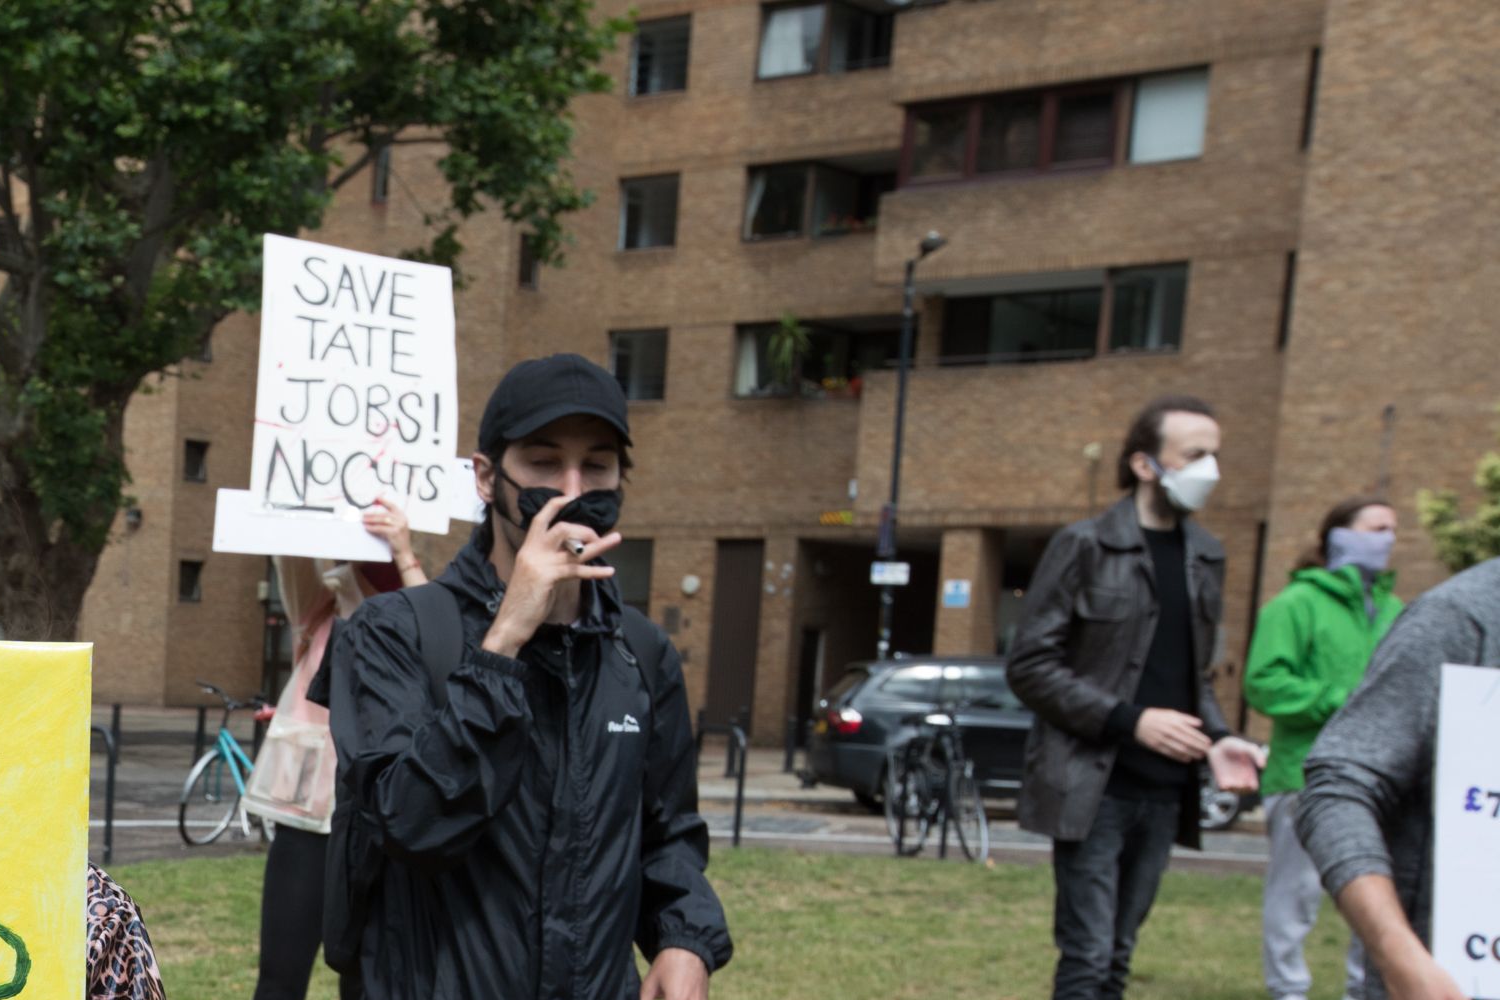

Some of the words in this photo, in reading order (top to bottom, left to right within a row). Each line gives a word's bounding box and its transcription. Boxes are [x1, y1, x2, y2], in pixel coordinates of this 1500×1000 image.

[293, 256, 416, 321] SAVE
[296, 315, 422, 378] TATE
[280, 376, 441, 446] JOBS!
